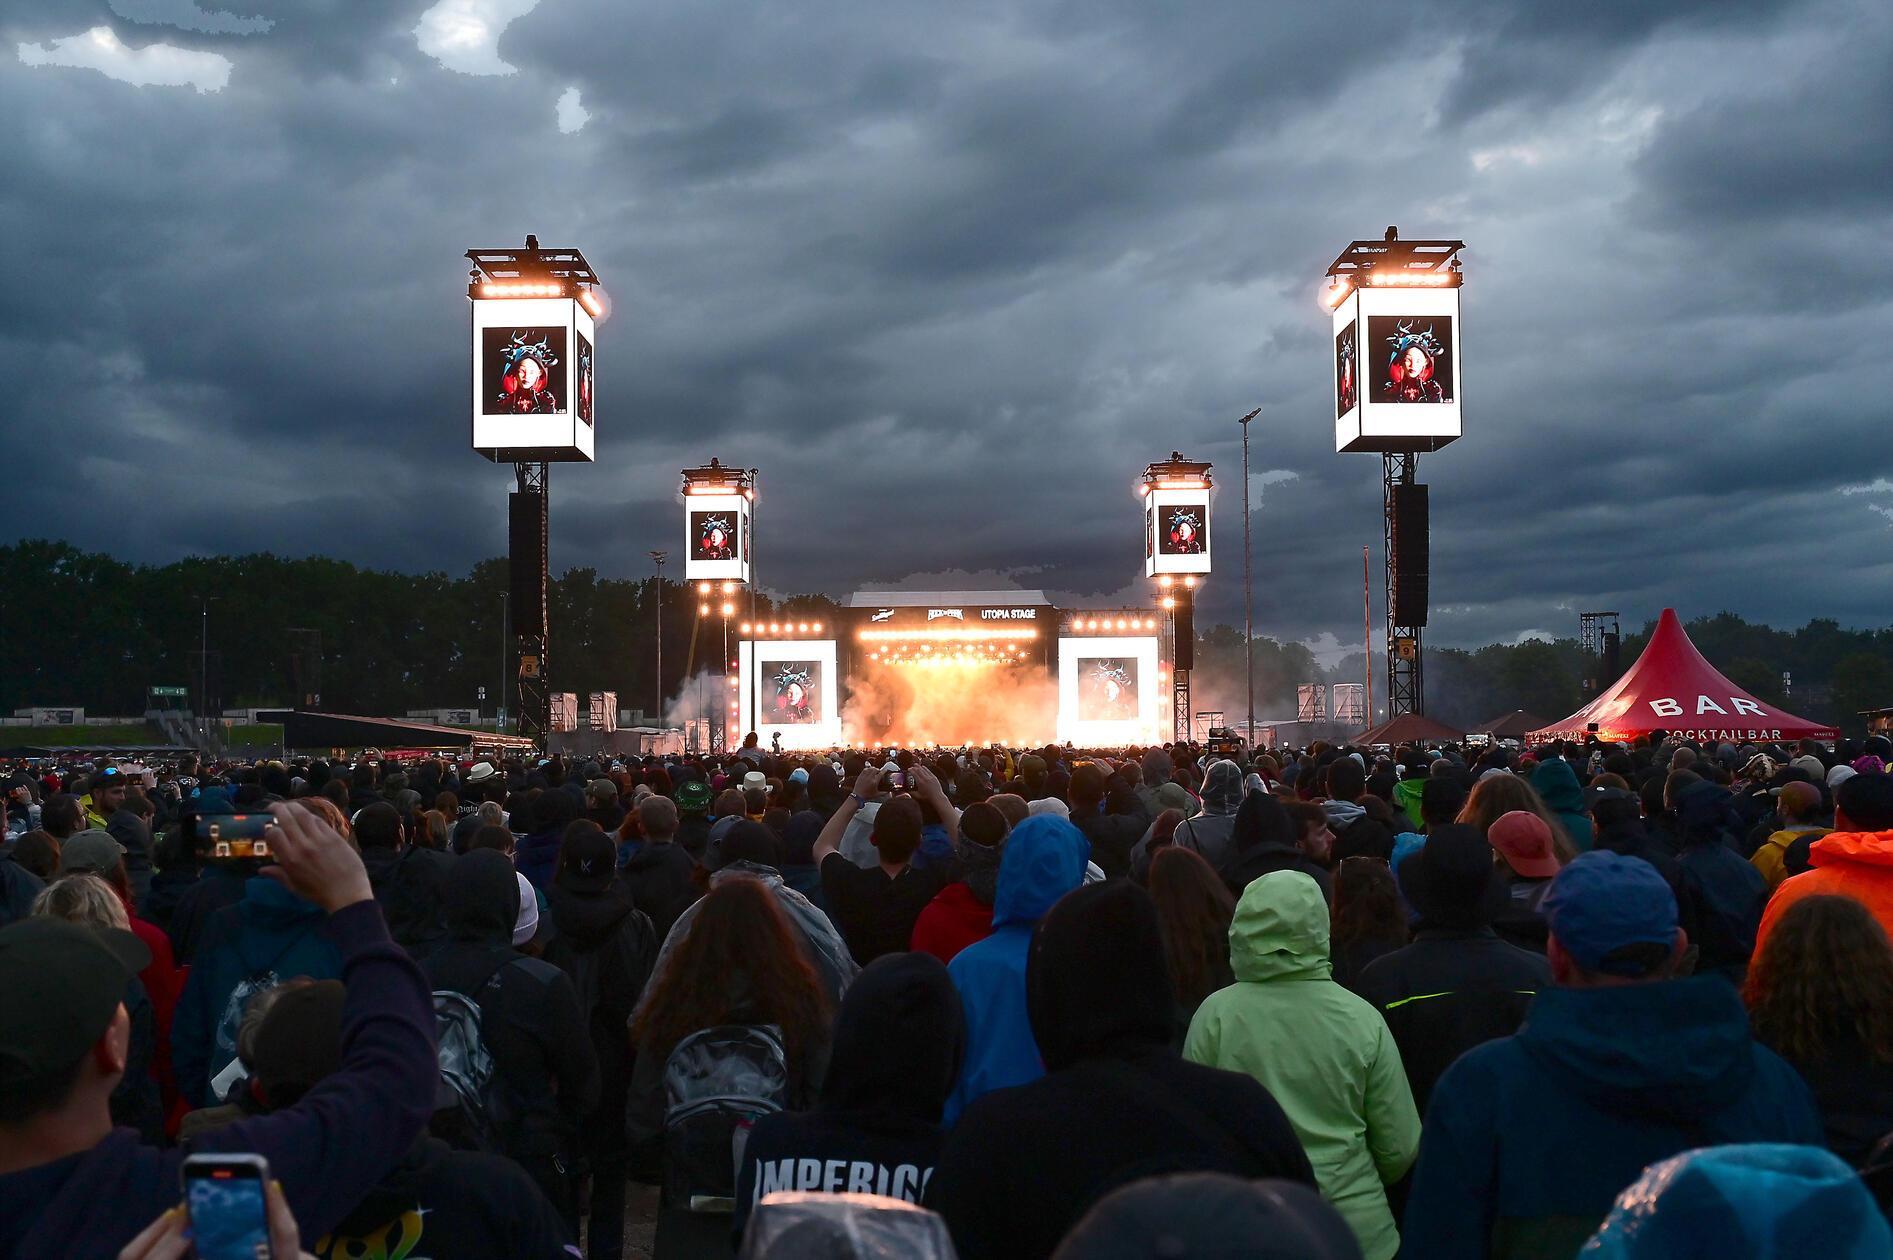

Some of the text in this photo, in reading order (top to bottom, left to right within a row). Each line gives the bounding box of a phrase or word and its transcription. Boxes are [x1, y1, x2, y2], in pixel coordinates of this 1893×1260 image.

[981, 608, 1036, 619] UTOPIA STAGE
[1648, 695, 1769, 717] BAR
[1649, 729, 1782, 740] OCKTAILBAR
